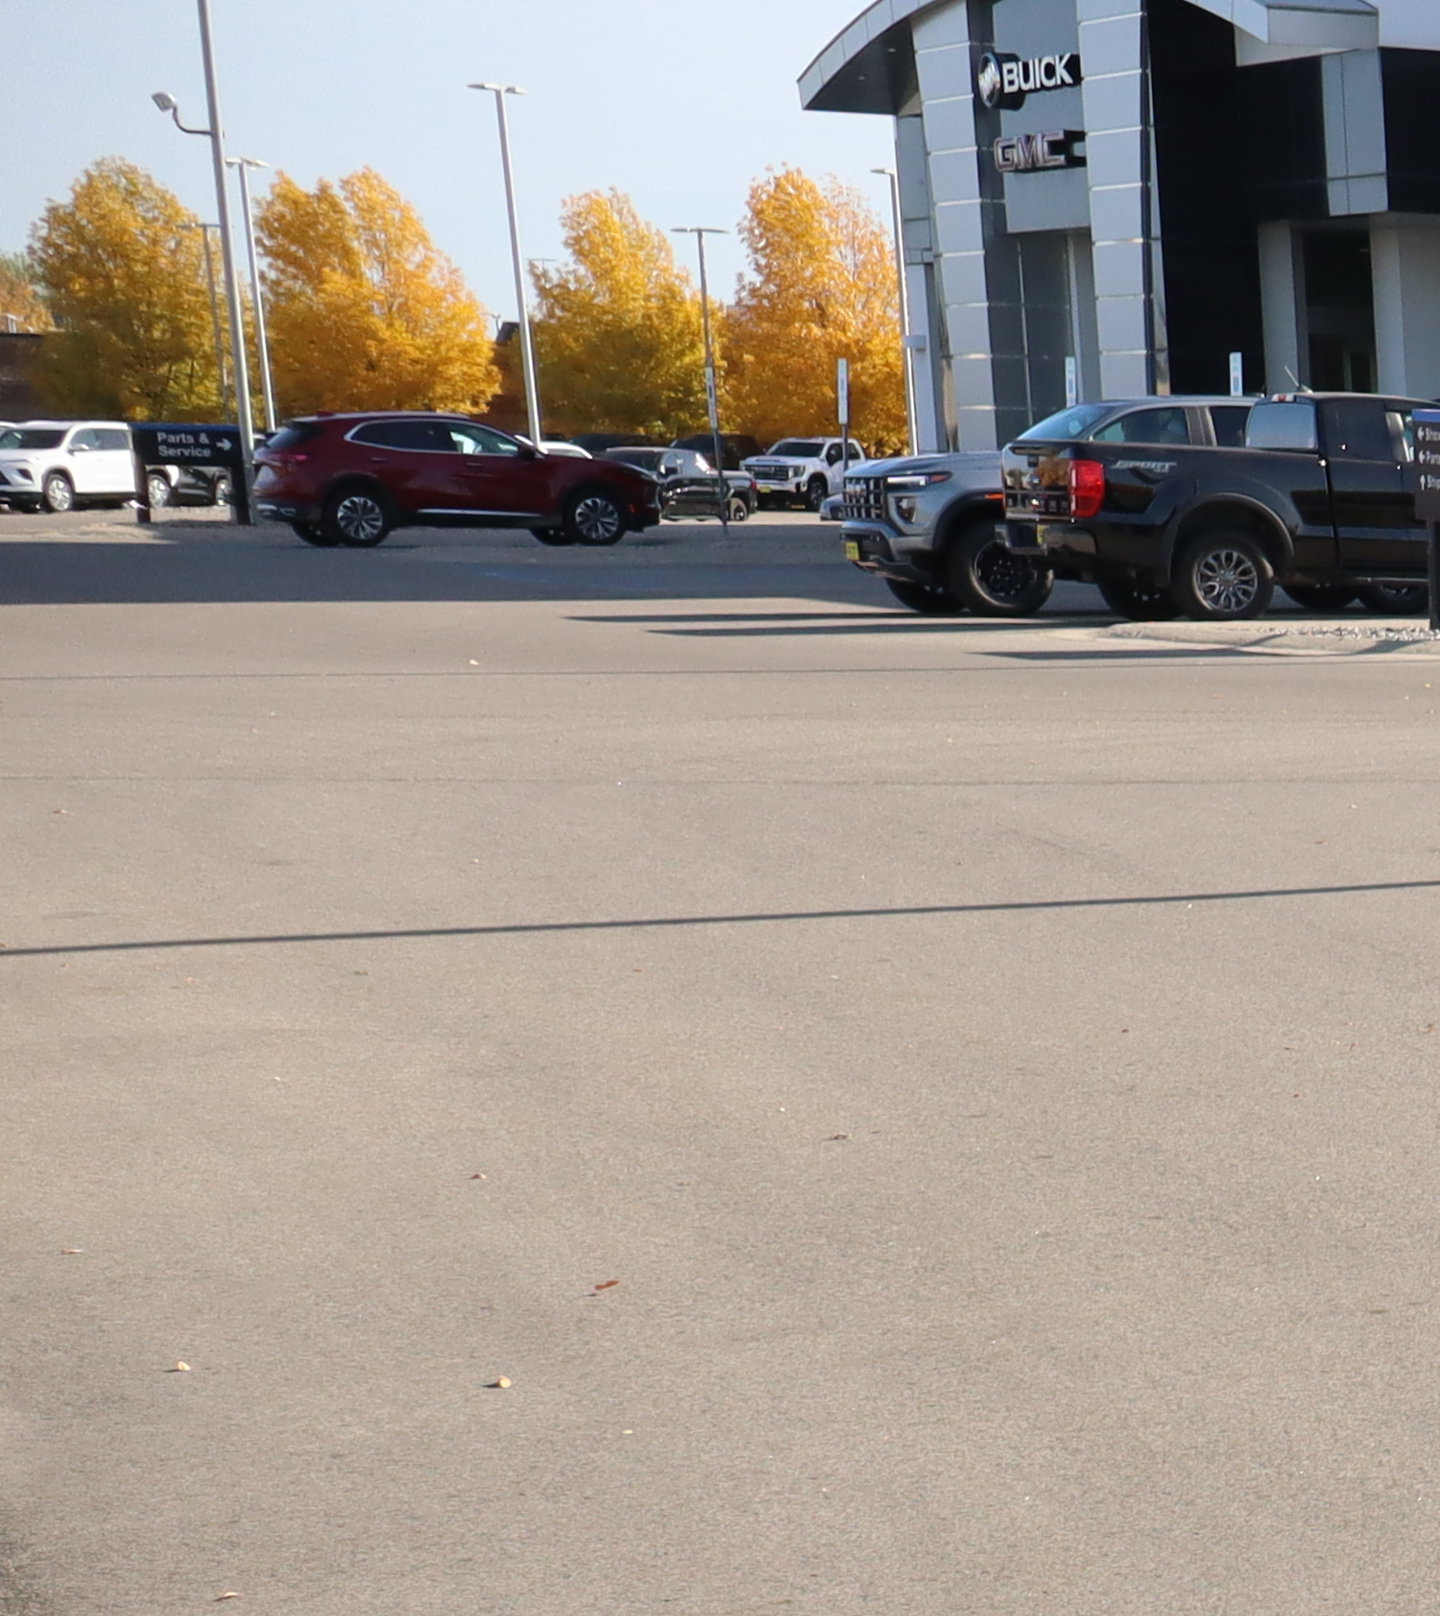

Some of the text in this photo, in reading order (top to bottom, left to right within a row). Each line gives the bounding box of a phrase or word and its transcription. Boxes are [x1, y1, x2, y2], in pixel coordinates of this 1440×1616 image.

[1002, 53, 1074, 93] BUICK
[994, 130, 1066, 172] GMC
[157, 432, 209, 444] Parts &
[158, 446, 211, 457] Service
